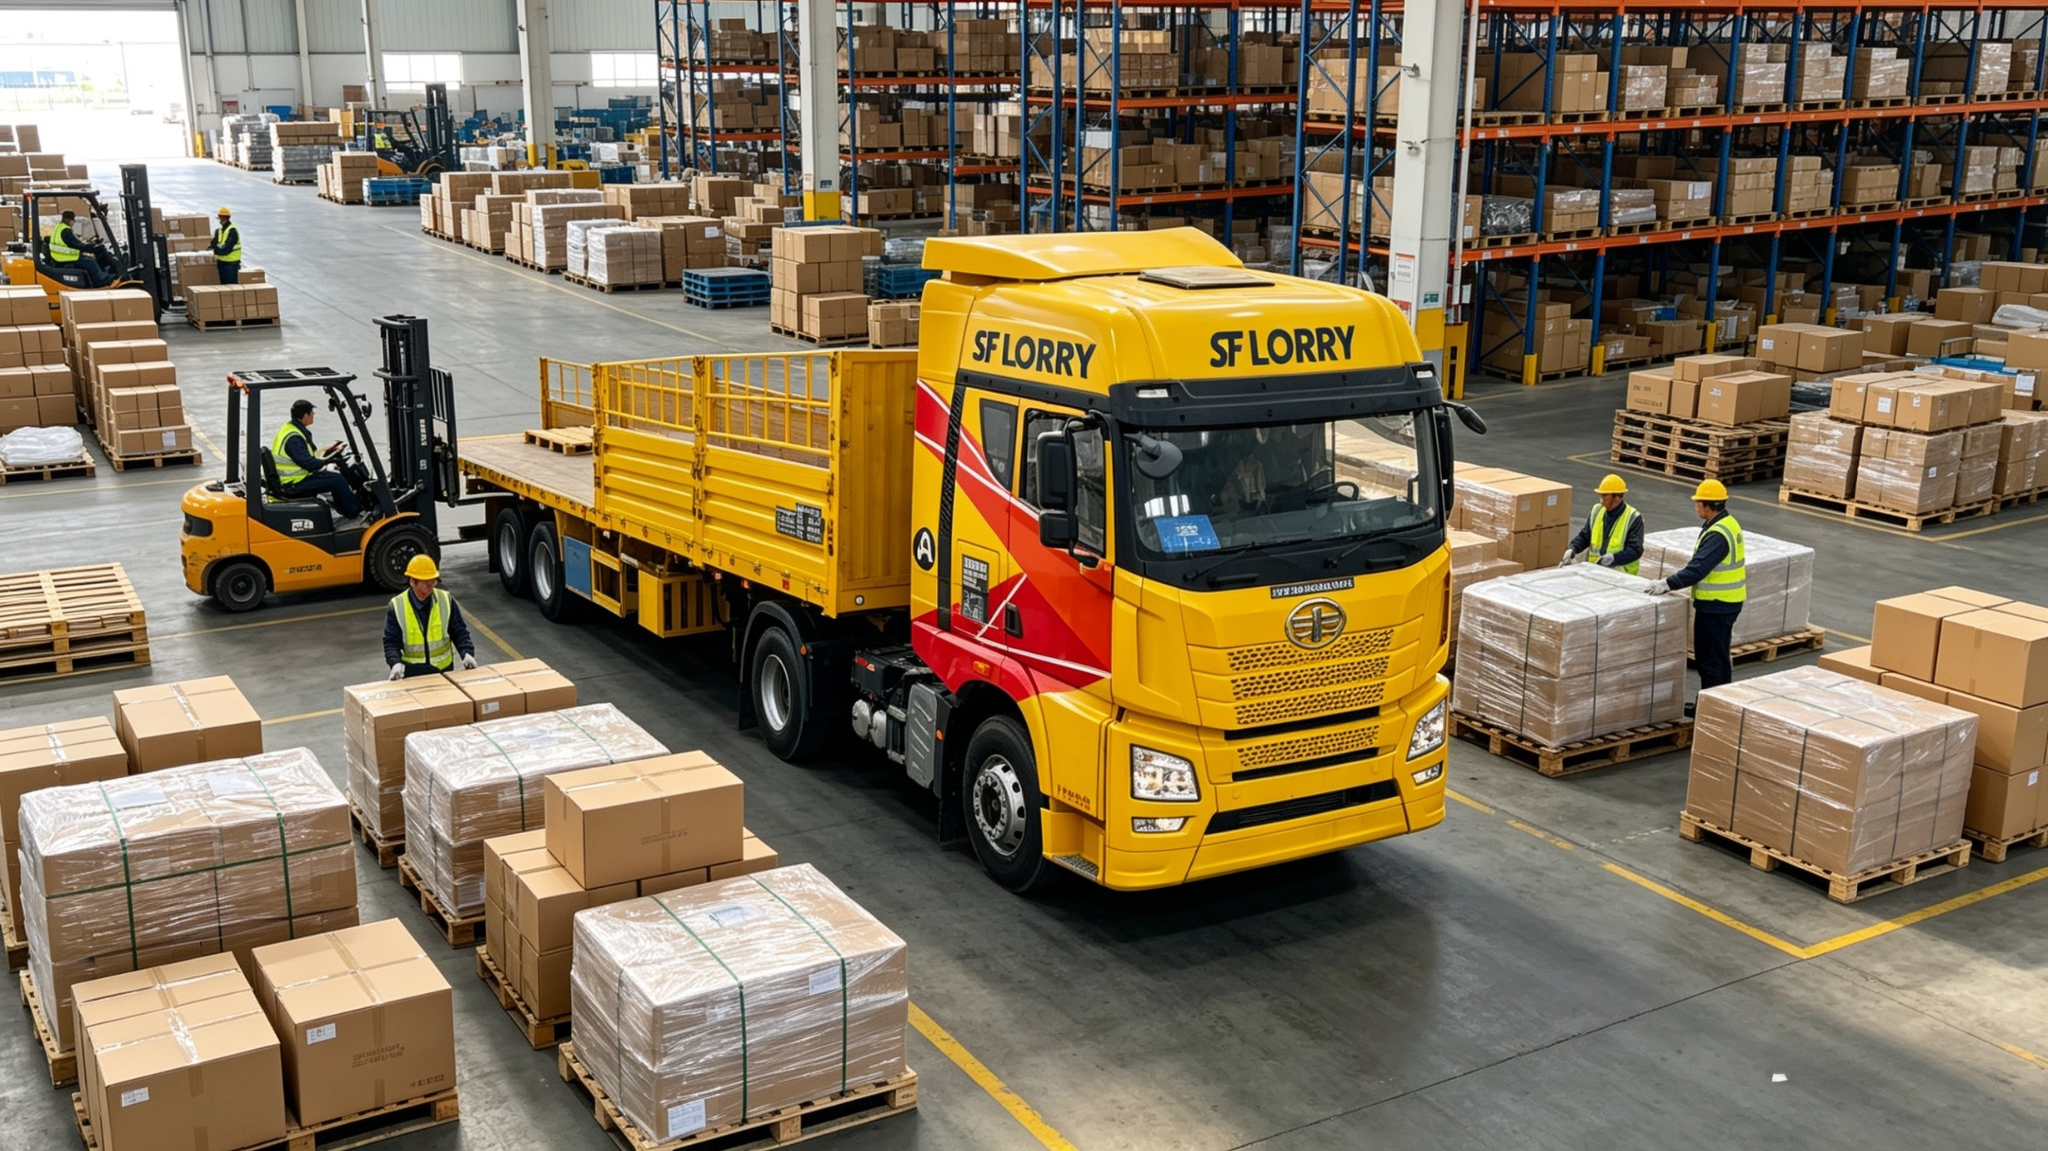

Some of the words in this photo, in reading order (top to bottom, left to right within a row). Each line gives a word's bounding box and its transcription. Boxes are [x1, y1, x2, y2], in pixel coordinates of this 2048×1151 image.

[972, 330, 1000, 363] SF
[1002, 333, 1097, 379] LORRY
[1210, 331, 1243, 368] SF
[1248, 325, 1355, 366] LORRY
[917, 531, 933, 563] A
